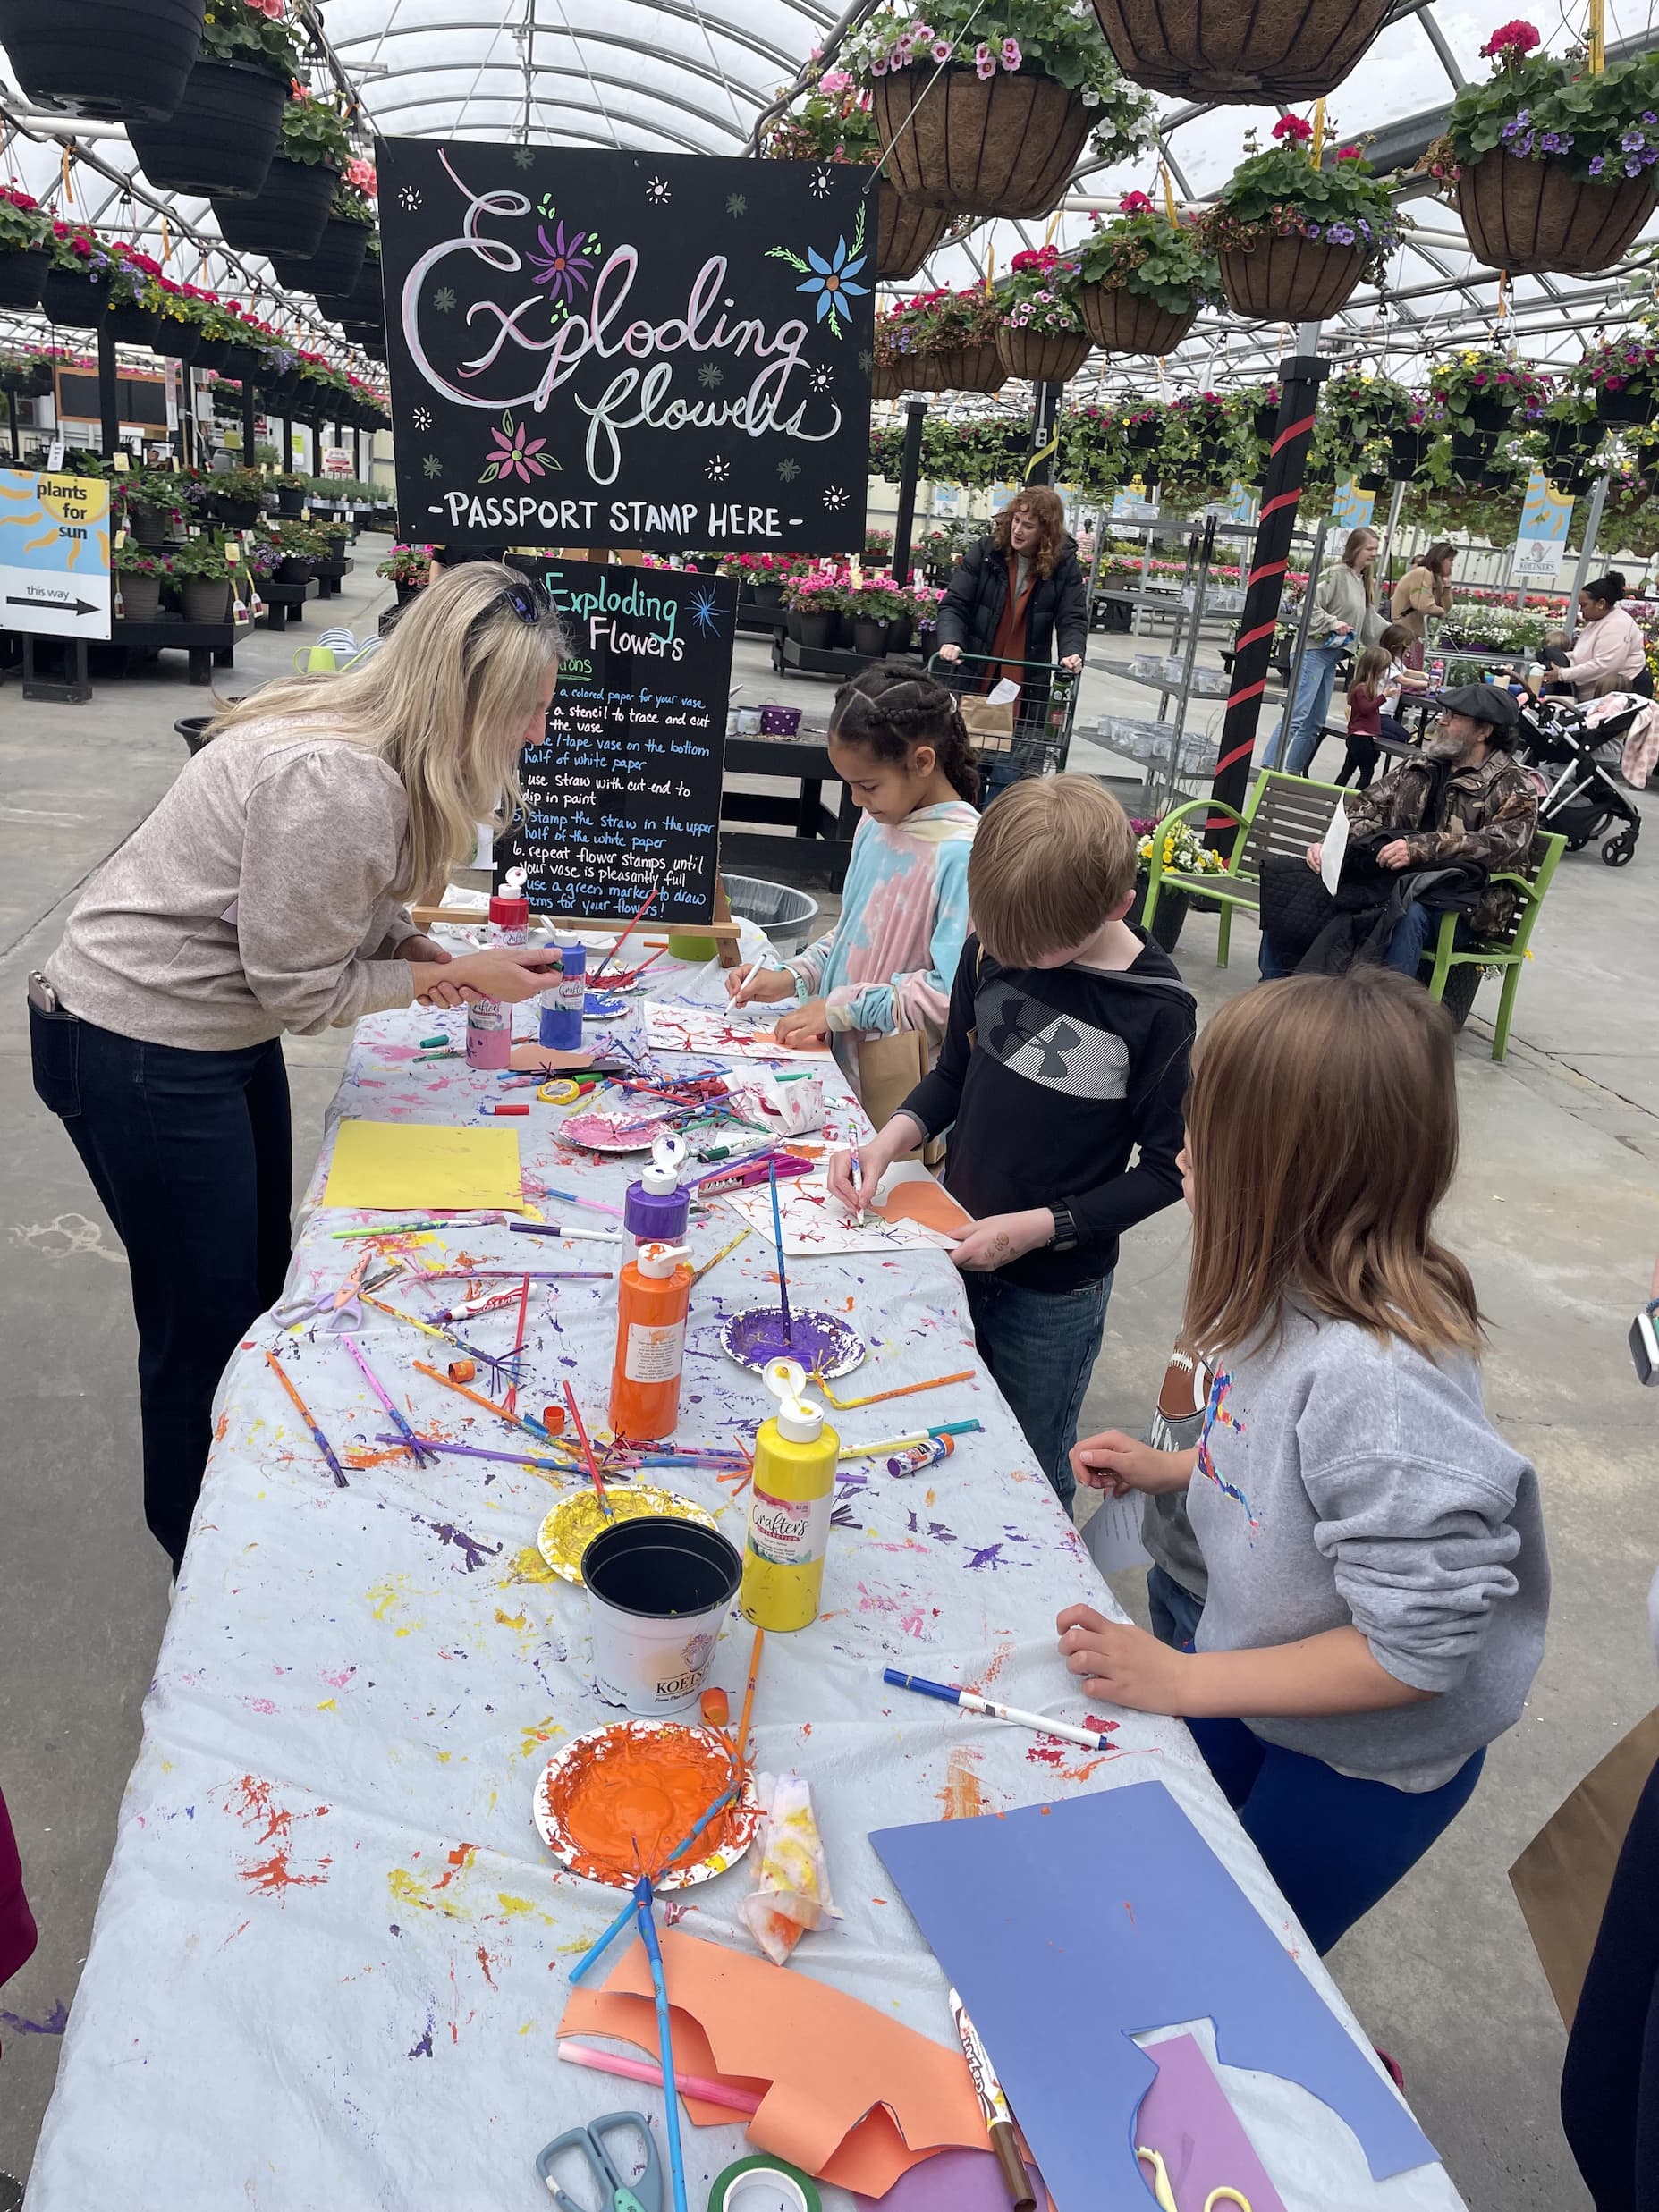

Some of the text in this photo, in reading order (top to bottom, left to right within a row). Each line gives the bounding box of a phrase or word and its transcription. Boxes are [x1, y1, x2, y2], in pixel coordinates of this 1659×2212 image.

[402, 148, 810, 418] Exploding
[574, 362, 842, 485] flowers
[37, 481, 87, 500] plants
[63, 502, 88, 519] for
[609, 501, 698, 536] STAMP
[59, 525, 88, 540] sun
[26, 585, 70, 601] this way
[545, 571, 678, 644] Exploding
[589, 615, 686, 662] Flowers
[560, 686, 707, 710] a colored paper for your vase
[549, 718, 605, 733] the vase
[554, 705, 711, 728] a stencil to trace and cut
[524, 747, 648, 774] half of white paper
[596, 739, 623, 751] vase
[626, 742, 640, 752] on
[644, 738, 666, 753] the
[670, 739, 710, 757] bottom
[522, 788, 597, 809] dip in paint
[527, 774, 549, 787] use
[595, 776, 625, 790] with
[674, 780, 691, 798] to
[529, 808, 569, 831] stamp
[570, 809, 595, 826] the
[644, 818, 656, 831] in
[662, 815, 685, 832] the
[685, 821, 715, 838] upper
[524, 823, 668, 853] half of the white paper
[512, 840, 526, 857] 6.
[528, 846, 571, 864] repeat
[575, 846, 618, 864] flower
[673, 853, 705, 874] until
[519, 860, 686, 891] your vase is pleasantly full
[519, 891, 664, 918] tems for your flowrs!
[526, 879, 707, 906] use a green marker to draw
[752, 1504, 809, 1537] Crafter's
